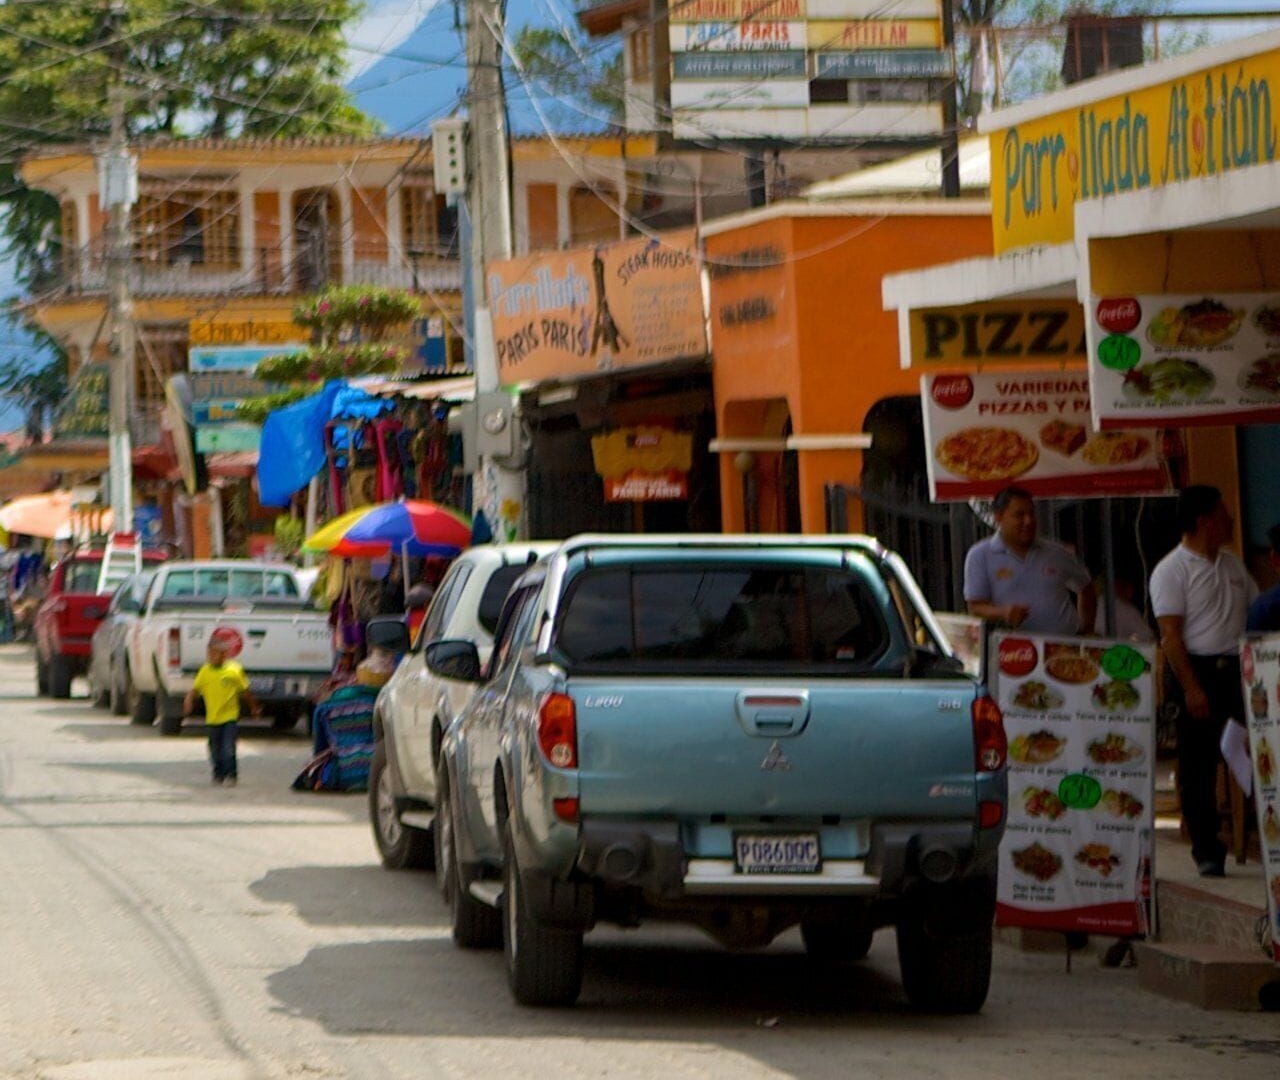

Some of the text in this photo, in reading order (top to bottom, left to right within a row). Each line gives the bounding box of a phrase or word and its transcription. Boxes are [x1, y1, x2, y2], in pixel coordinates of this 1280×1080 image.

[740, 20, 790, 40] PARIS
[842, 22, 908, 45] ATITLAN
[651, 248, 694, 269] HOUSE
[497, 318, 589, 369] PARIS PARIS
[978, 398, 1050, 416] PIZZAS
